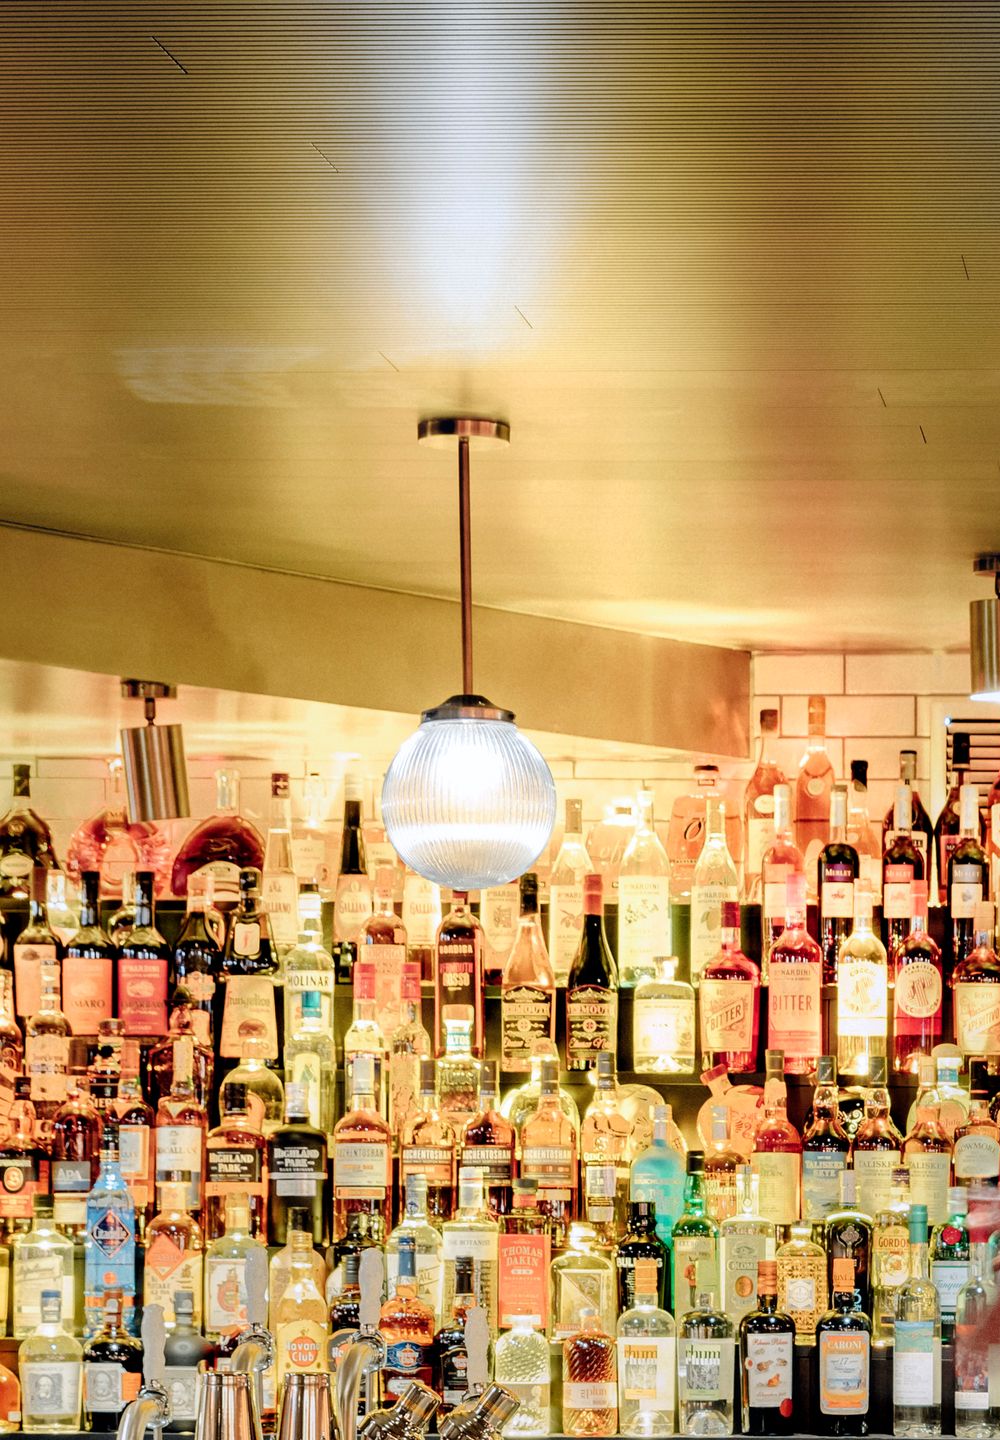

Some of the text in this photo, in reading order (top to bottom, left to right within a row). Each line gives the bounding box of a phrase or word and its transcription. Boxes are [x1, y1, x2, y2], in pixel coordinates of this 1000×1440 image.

[772, 995, 813, 1011] BITTER
[710, 1003, 742, 1030] BITTER
[208, 1152, 254, 1164] HIGHLAND
[879, 1238, 906, 1248] GORDO
[501, 1245, 544, 1258] THOMAS
[506, 1256, 539, 1267] DAKIN
[616, 1256, 663, 1268] BULLG
[827, 1340, 862, 1349] CARONI
[291, 1352, 315, 1362] Club
